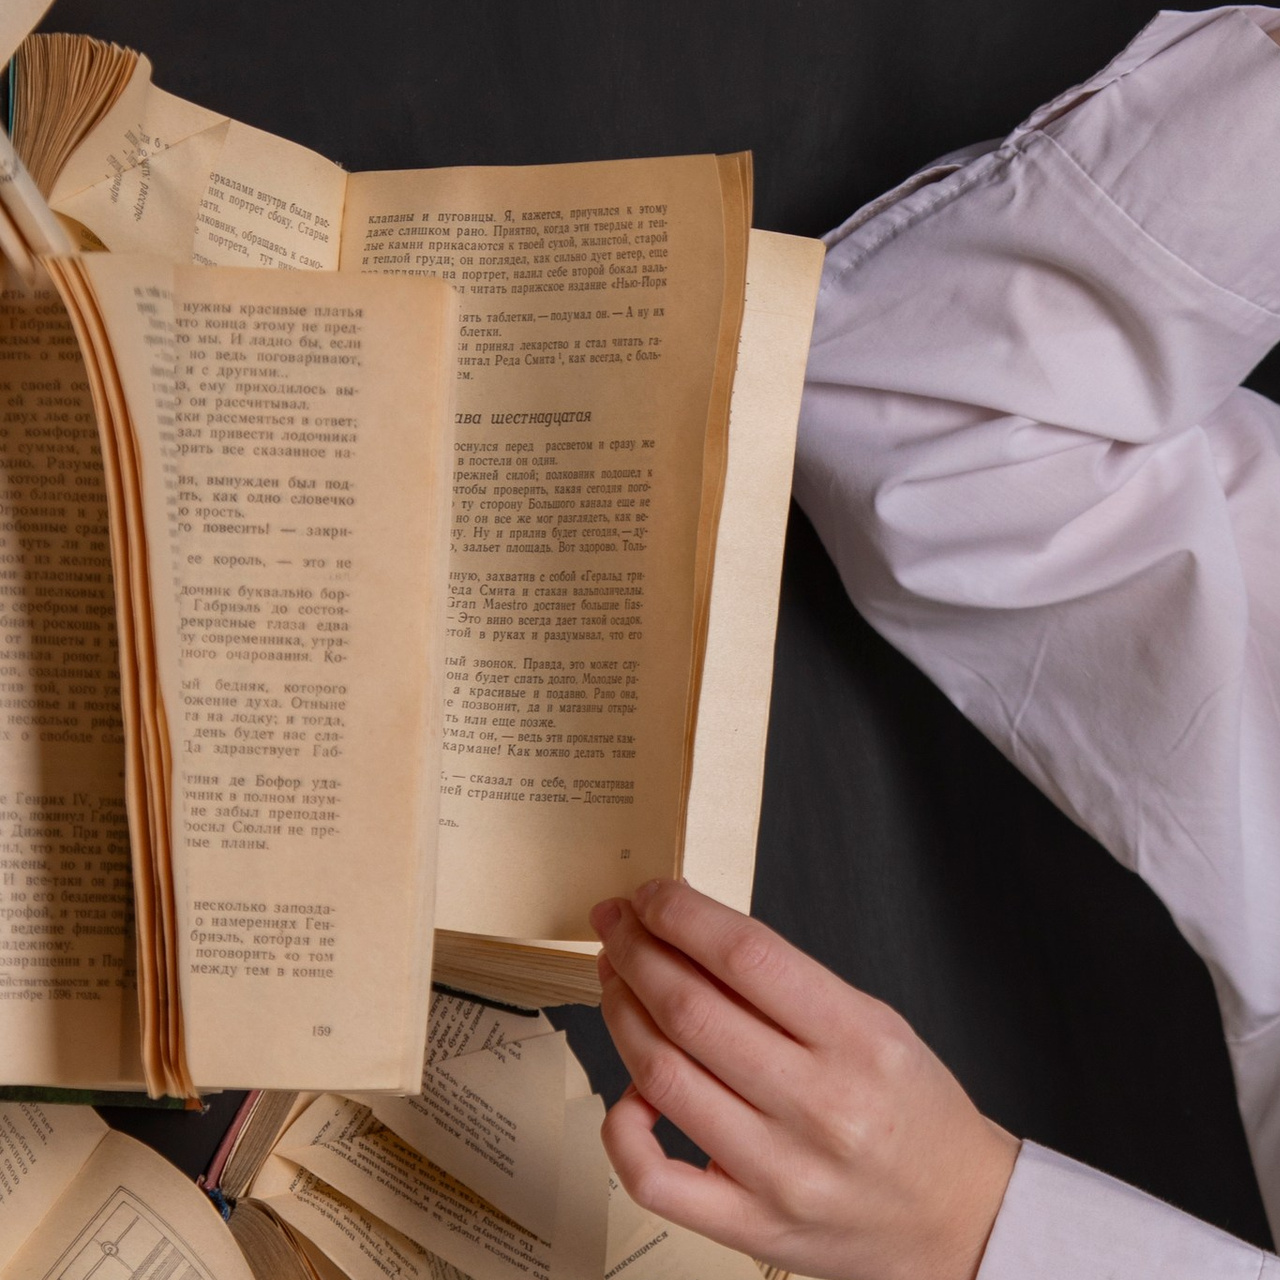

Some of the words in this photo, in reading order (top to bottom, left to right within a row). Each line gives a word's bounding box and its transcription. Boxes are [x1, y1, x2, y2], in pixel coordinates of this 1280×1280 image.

[368, 213, 414, 224] клапаны
[422, 213, 429, 222] и
[504, 210, 515, 223] Я,
[570, 207, 619, 220] приучился
[627, 206, 632, 215] к
[639, 204, 668, 216] этому
[366, 228, 394, 238] даже
[398, 227, 450, 236] слишком
[544, 224, 569, 234] когда
[574, 223, 590, 233] эти
[593, 221, 633, 233] твердые
[637, 221, 643, 229] и
[362, 257, 369, 265] и
[373, 253, 410, 264] теплой
[459, 256, 474, 265] он
[533, 255, 550, 264] как
[554, 253, 587, 263] сильно
[590, 252, 612, 263] дует
[649, 249, 668, 258] еще
[183, 303, 232, 315] нужны
[240, 305, 307, 317] красивые
[314, 307, 363, 318] платья
[190, 350, 206, 360] но
[215, 351, 247, 362] ведь
[491, 411, 591, 427] шестнадцатая
[457, 457, 464, 466] в
[469, 457, 512, 466] постели
[516, 457, 528, 466] он
[194, 601, 261, 615] Габриэль
[271, 605, 288, 615] до
[482, 598, 528, 611] Maestro
[533, 602, 576, 612] достанет
[581, 599, 619, 610] большие
[284, 684, 347, 695] которого
[229, 777, 245, 787] де
[255, 775, 302, 791] Бофор
[194, 901, 267, 913] несколько
[312, 1026, 332, 1037] 159
